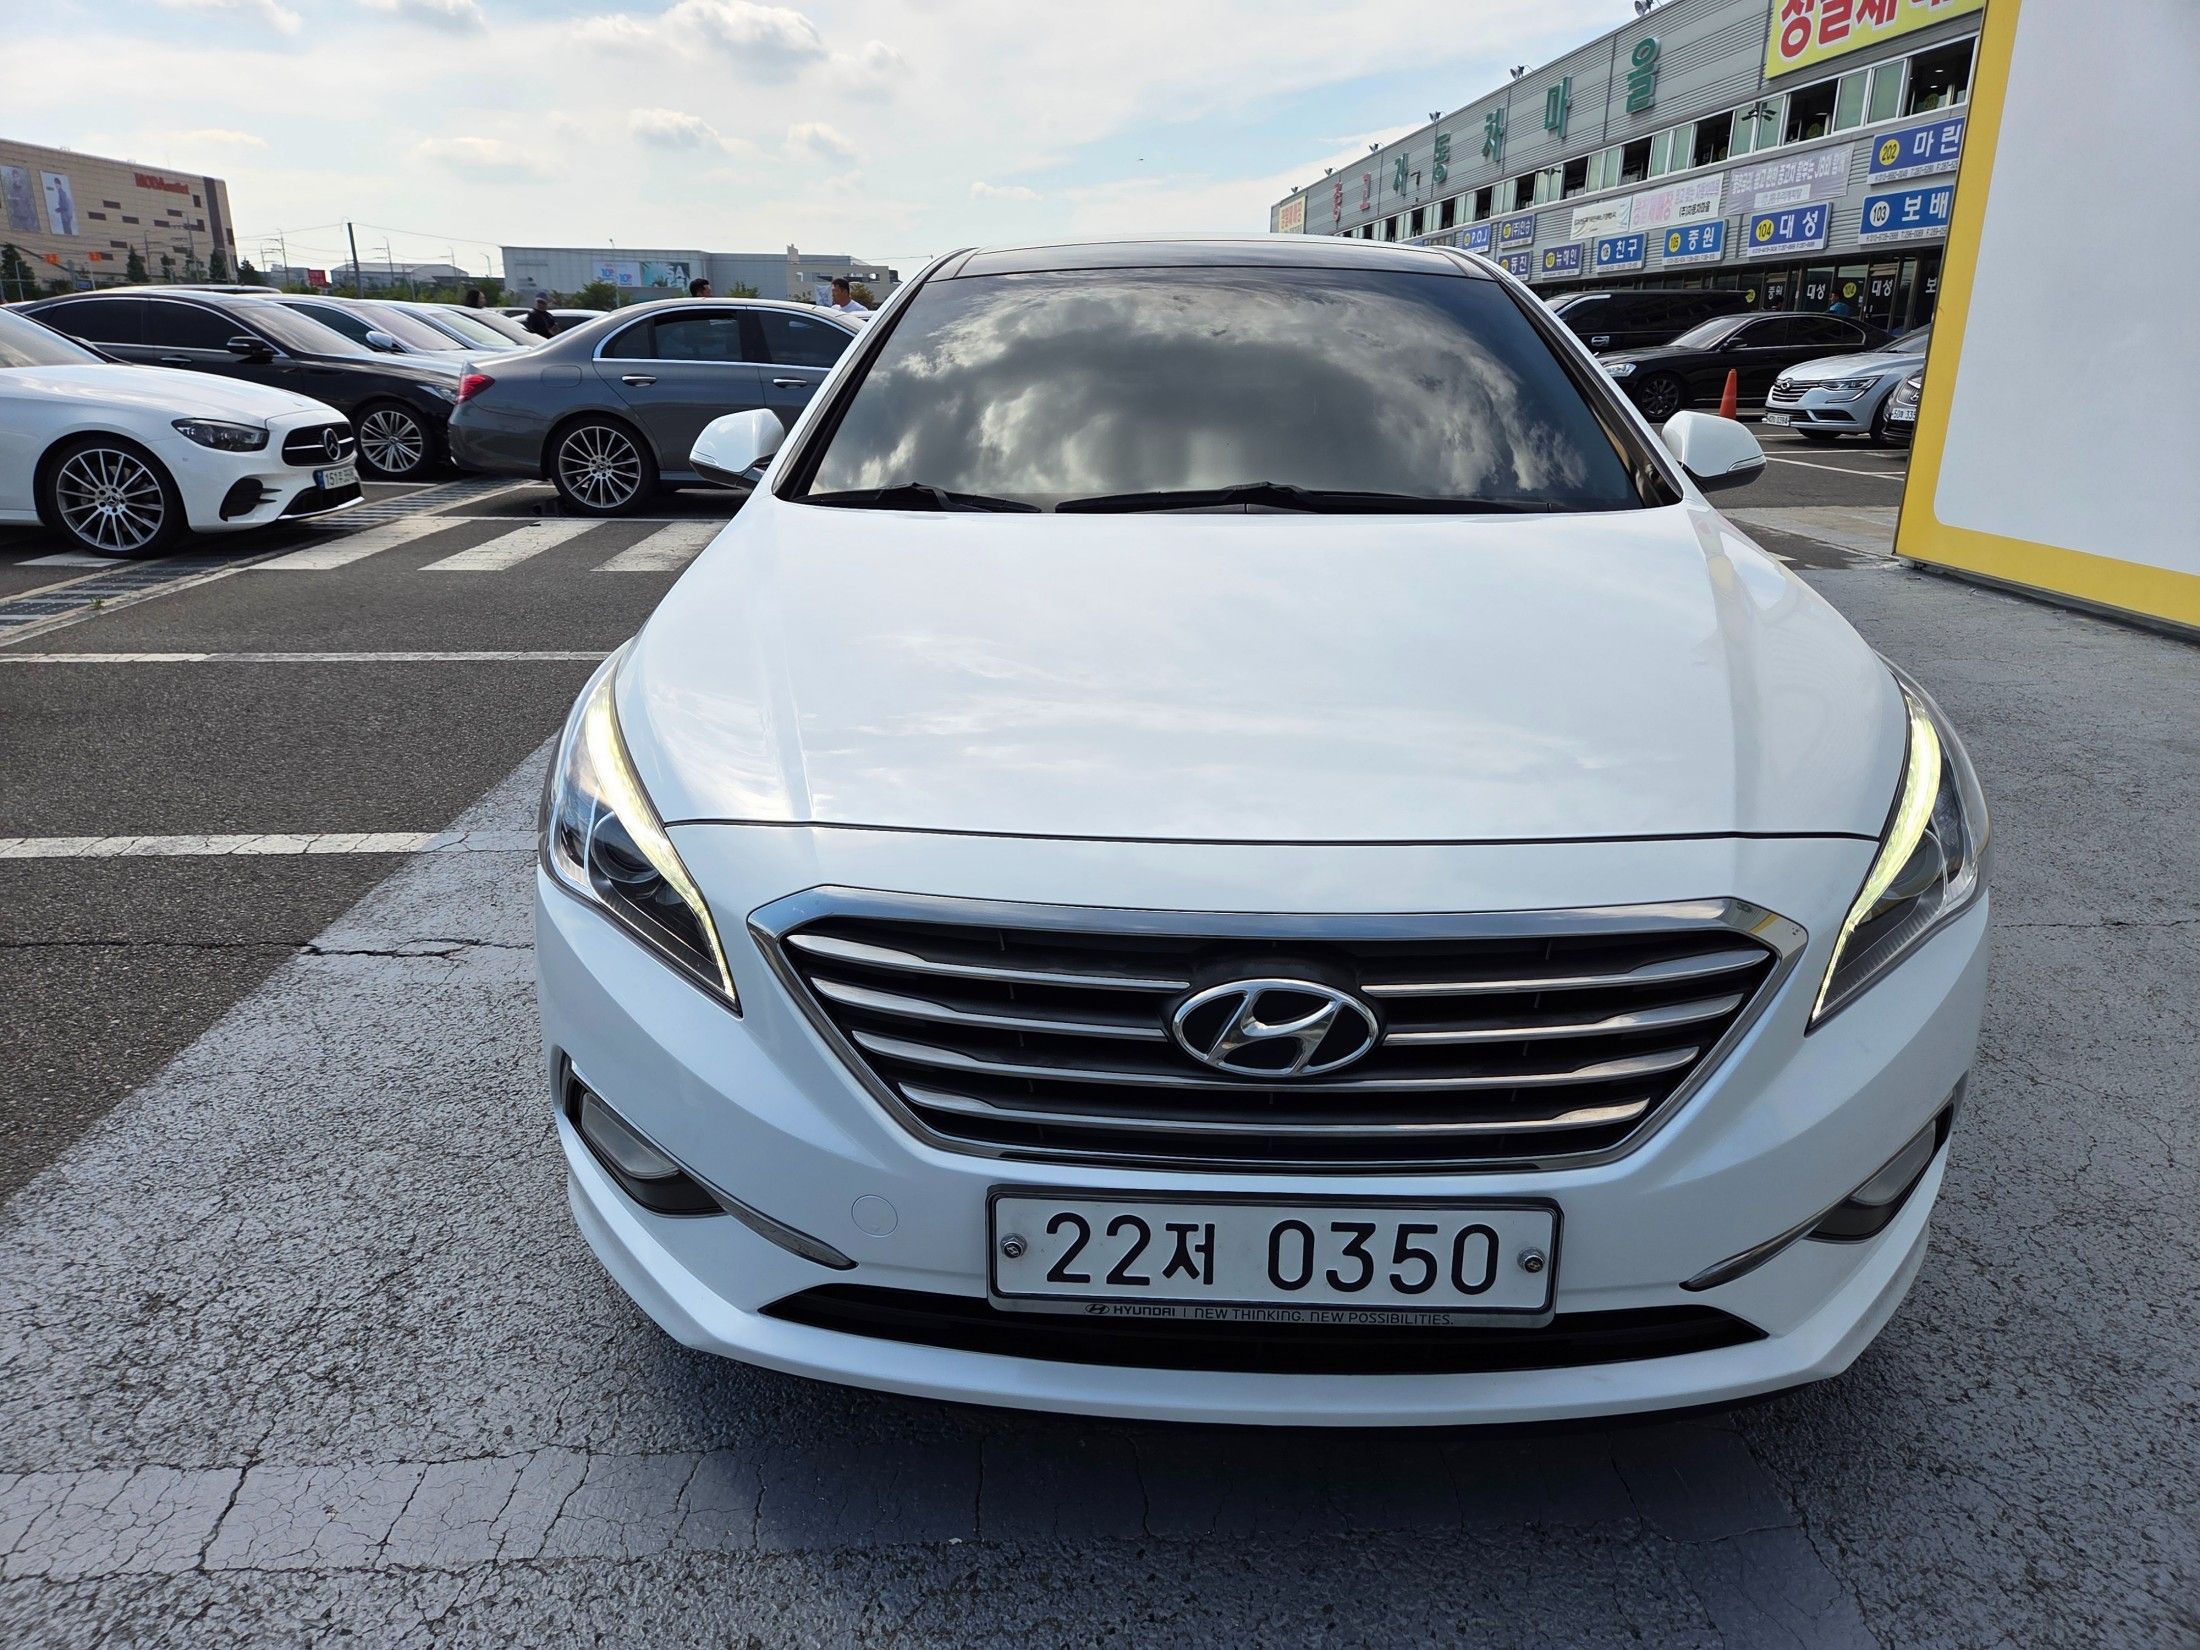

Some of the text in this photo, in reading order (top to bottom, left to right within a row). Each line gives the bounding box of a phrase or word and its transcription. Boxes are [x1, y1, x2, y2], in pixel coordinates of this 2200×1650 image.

[1881, 143, 1898, 161] 202
[1872, 206, 1887, 222] 103
[1758, 223, 1772, 238] 104
[1615, 238, 1638, 259] 친구
[1806, 283, 1826, 301] 대성
[1871, 279, 1894, 298] 대성
[1045, 1211, 1501, 1296] 22저 0350
[1113, 1304, 1175, 1317] HYUNDAI
[1194, 1307, 1228, 1320] NEW
[1310, 1311, 1344, 1323] NEW
